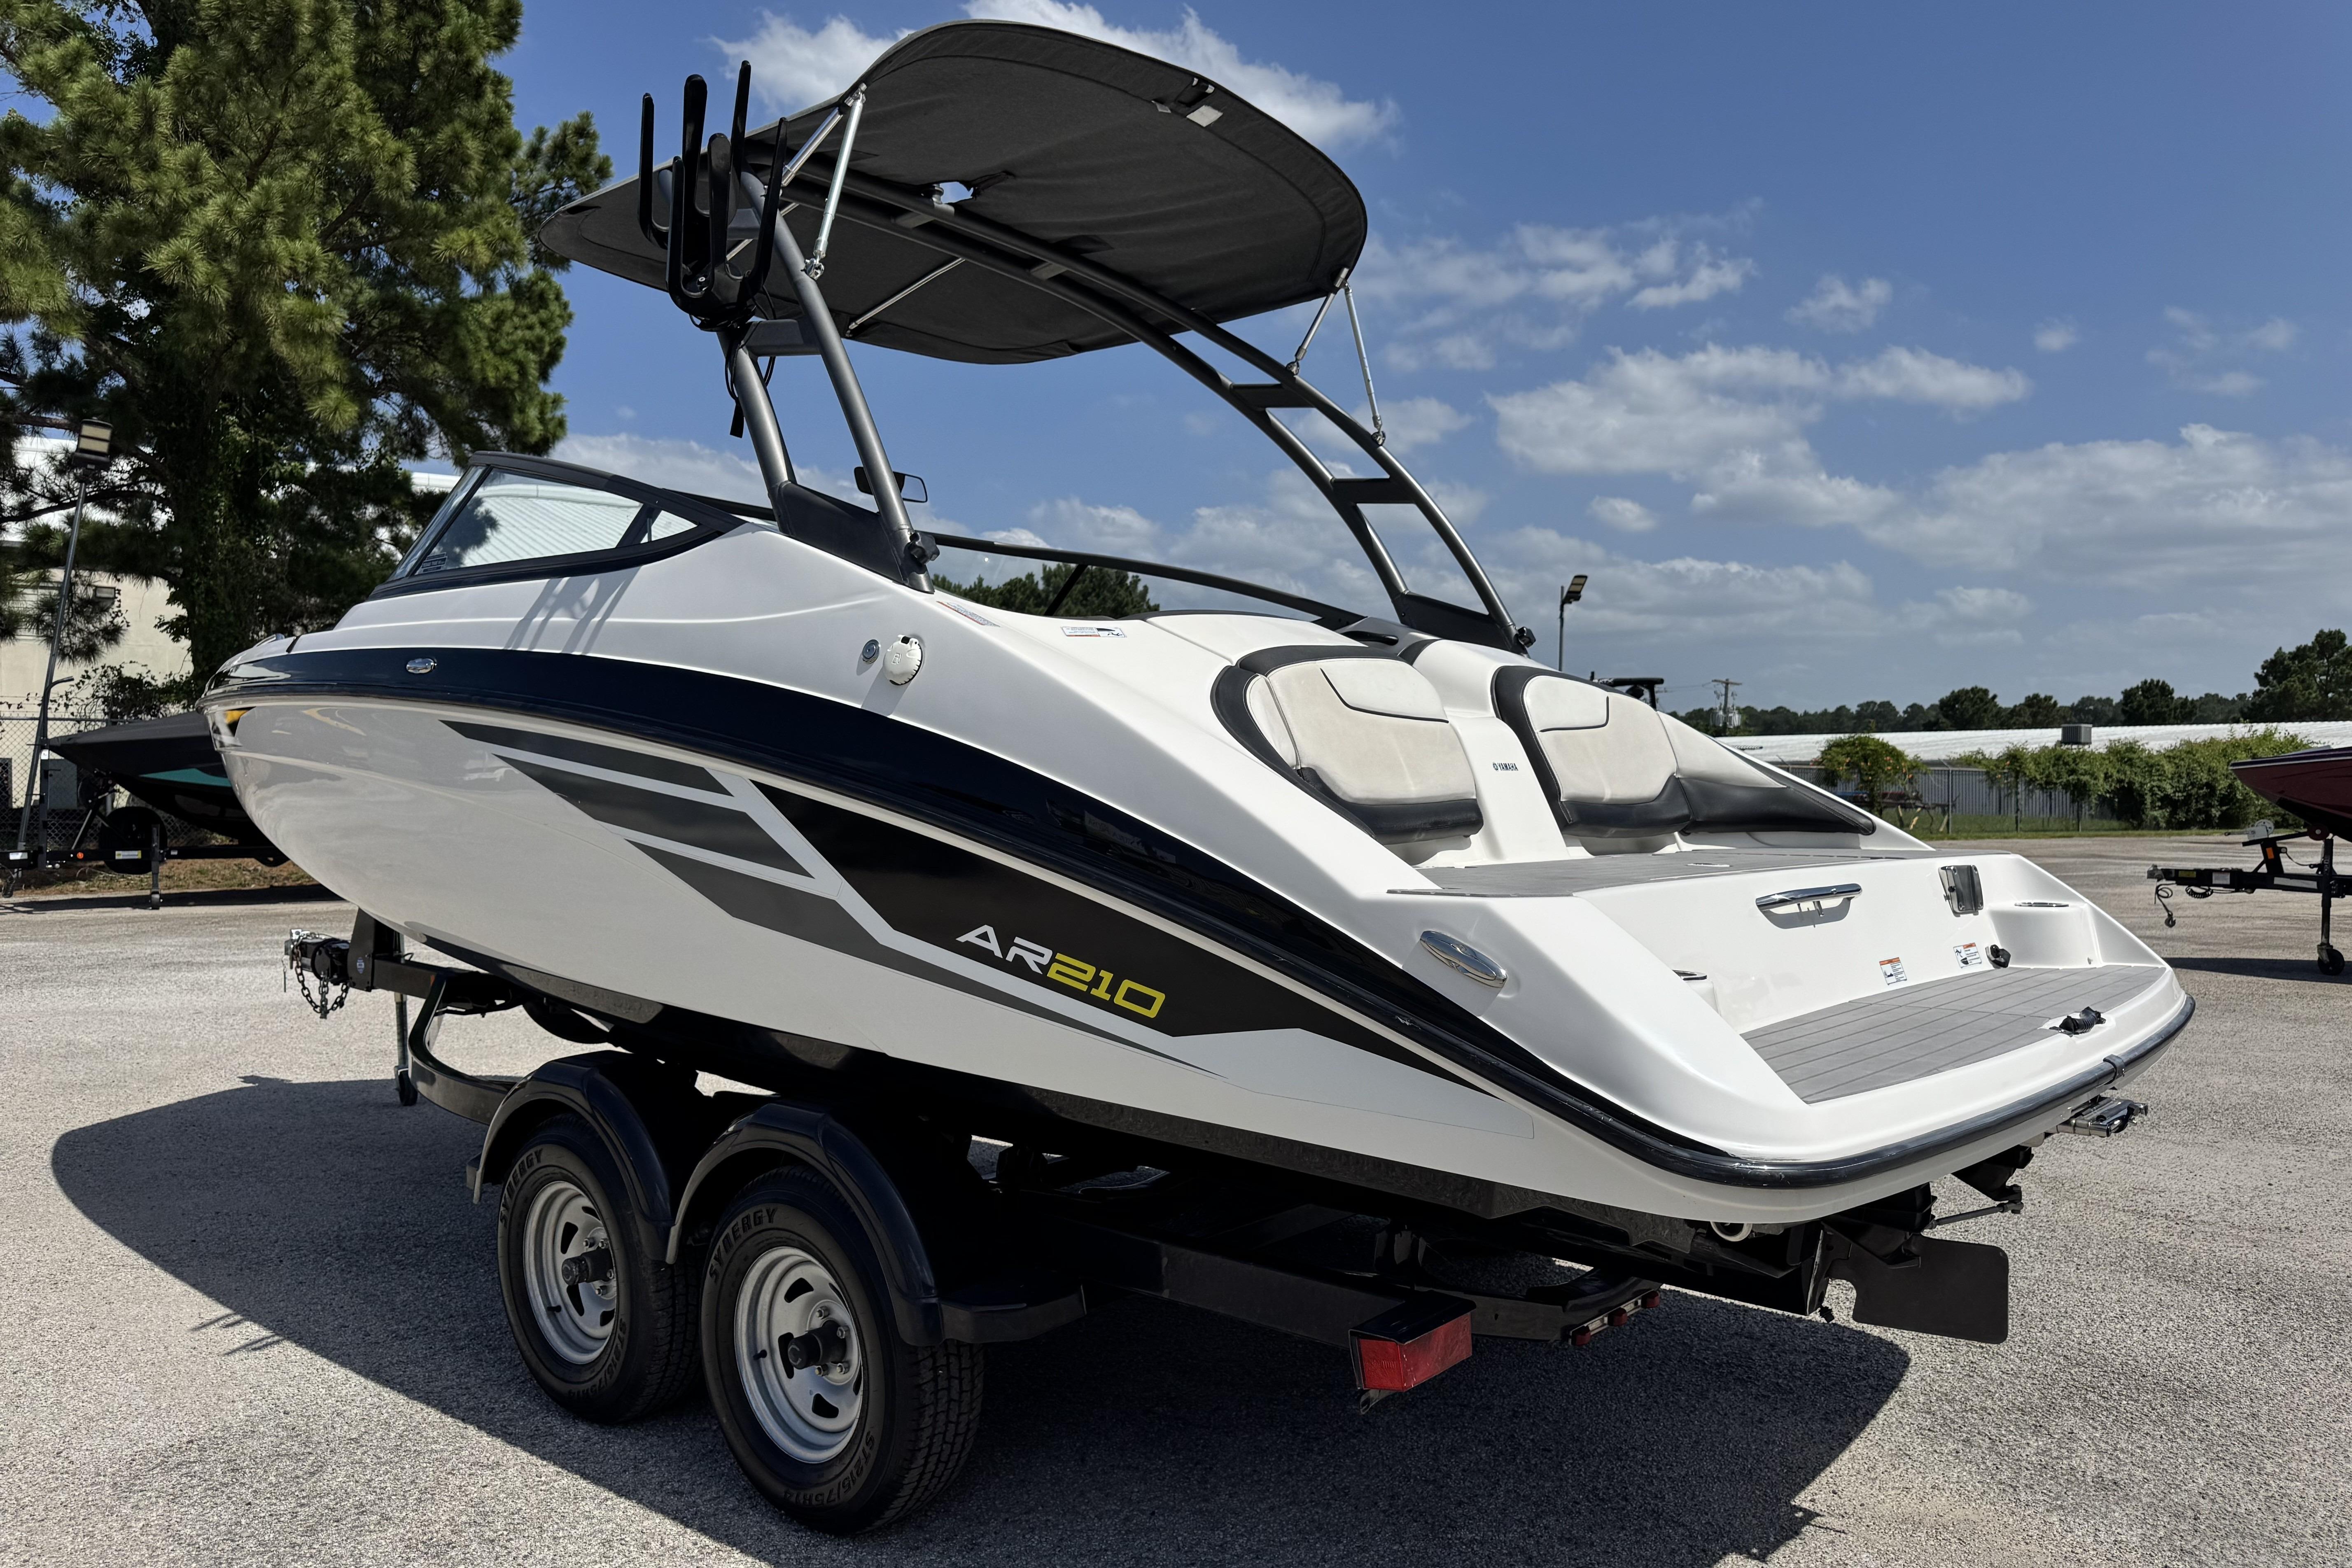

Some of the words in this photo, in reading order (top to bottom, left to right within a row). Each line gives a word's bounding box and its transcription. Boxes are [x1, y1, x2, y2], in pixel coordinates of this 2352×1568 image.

[956, 924, 1165, 1018] AR210
[500, 1148, 543, 1228] SYNERGY
[709, 1207, 778, 1283] SYNERGY
